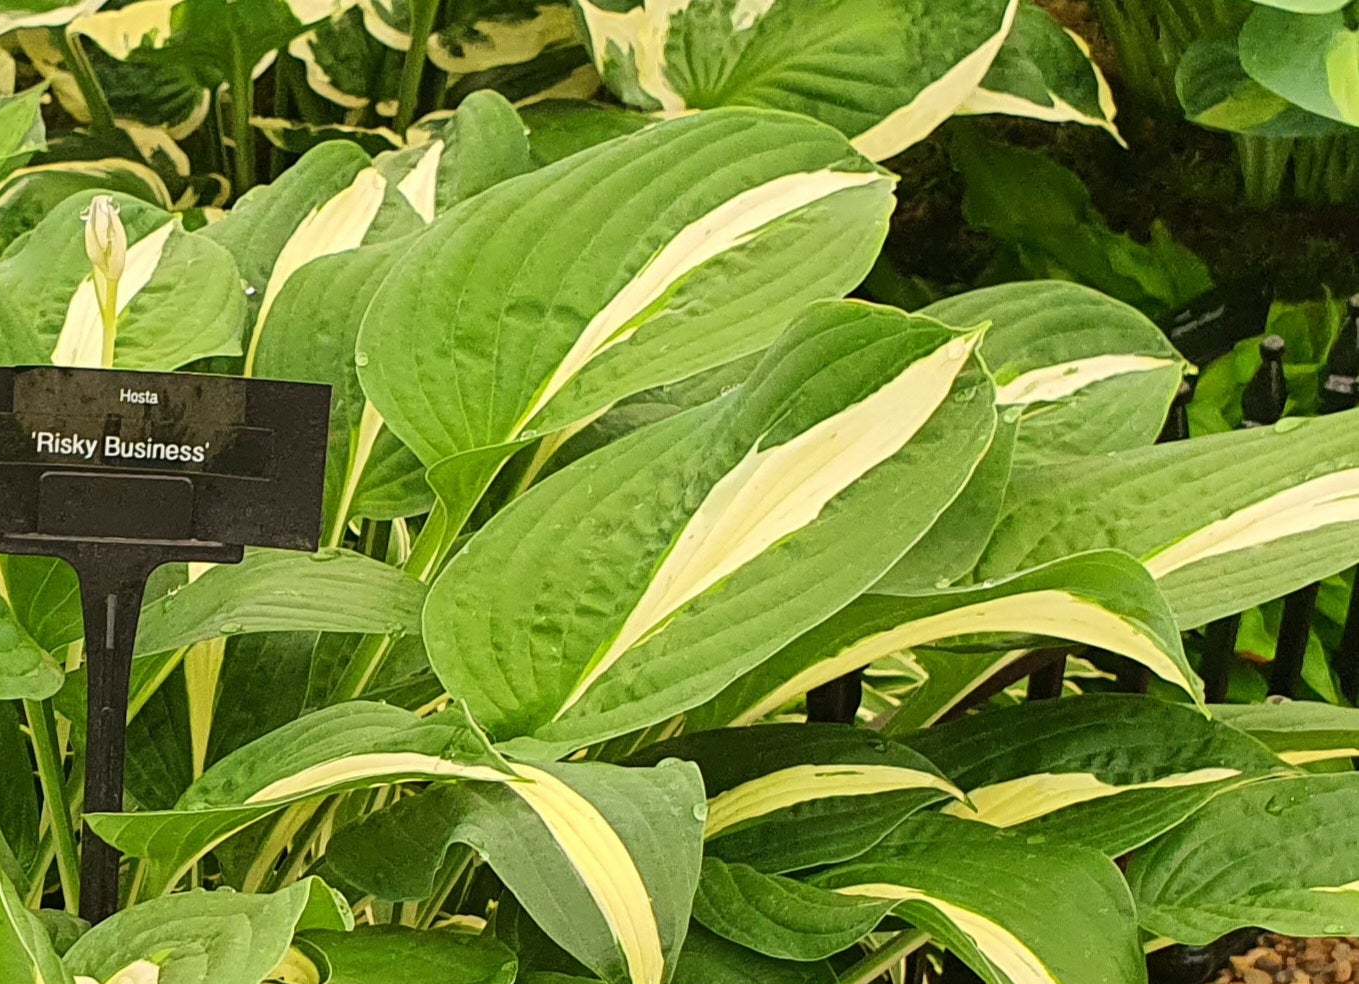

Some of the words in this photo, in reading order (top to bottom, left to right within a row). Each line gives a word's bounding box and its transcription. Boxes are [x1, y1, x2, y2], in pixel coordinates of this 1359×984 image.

[119, 388, 158, 404] Hosta
[31, 431, 97, 459] 'Risky
[104, 435, 210, 463] Business'
